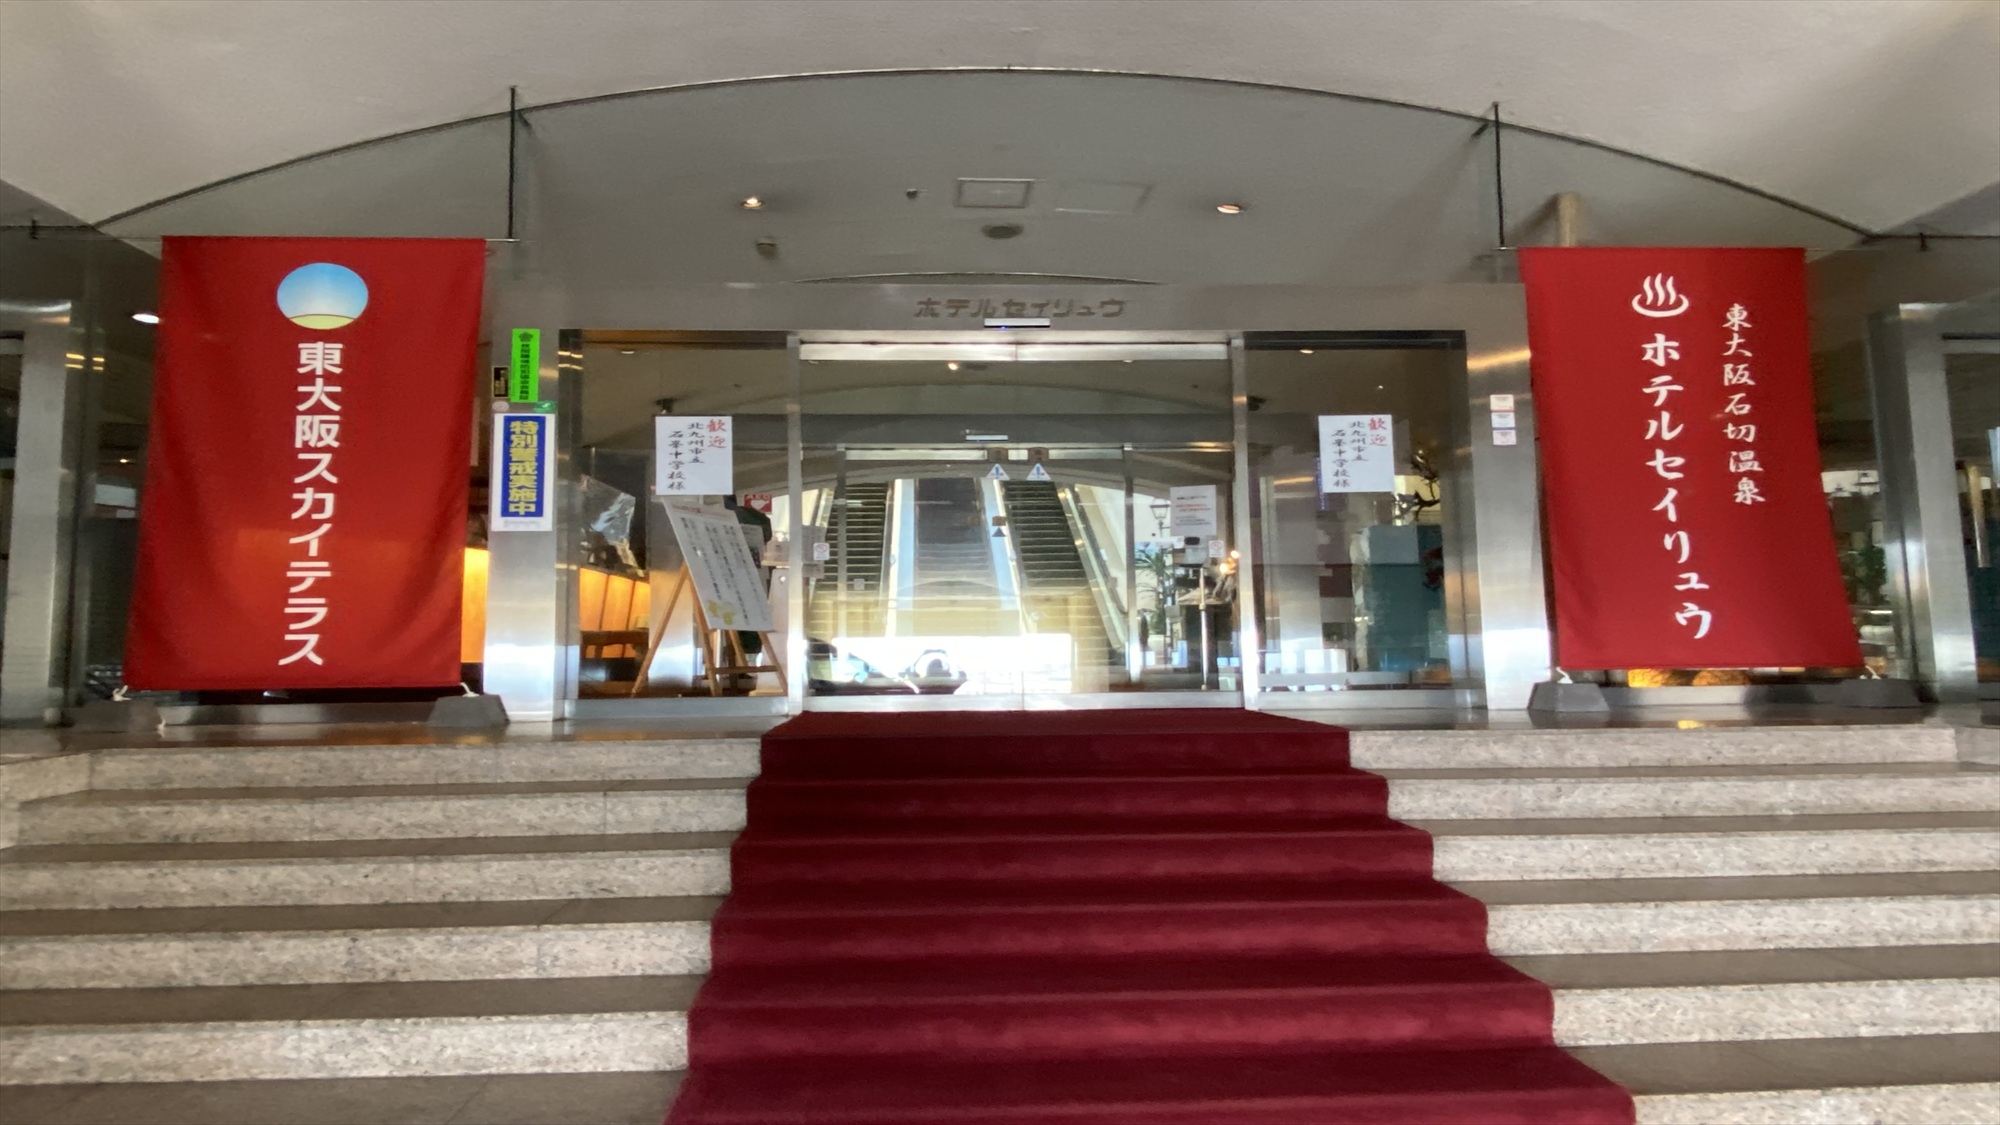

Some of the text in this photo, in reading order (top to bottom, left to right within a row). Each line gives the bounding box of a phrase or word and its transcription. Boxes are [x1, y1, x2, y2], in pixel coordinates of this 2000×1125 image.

[913, 298, 1126, 318] ホテルセイリュウ
[508, 420, 539, 516] 特別警戒実施中
[687, 422, 705, 464] 北九州市立
[1722, 303, 1766, 505] 東大阪石切温泉
[278, 341, 344, 666] 東大阪スカイテラス
[1641, 333, 1712, 639] ホテルセイリュウ
